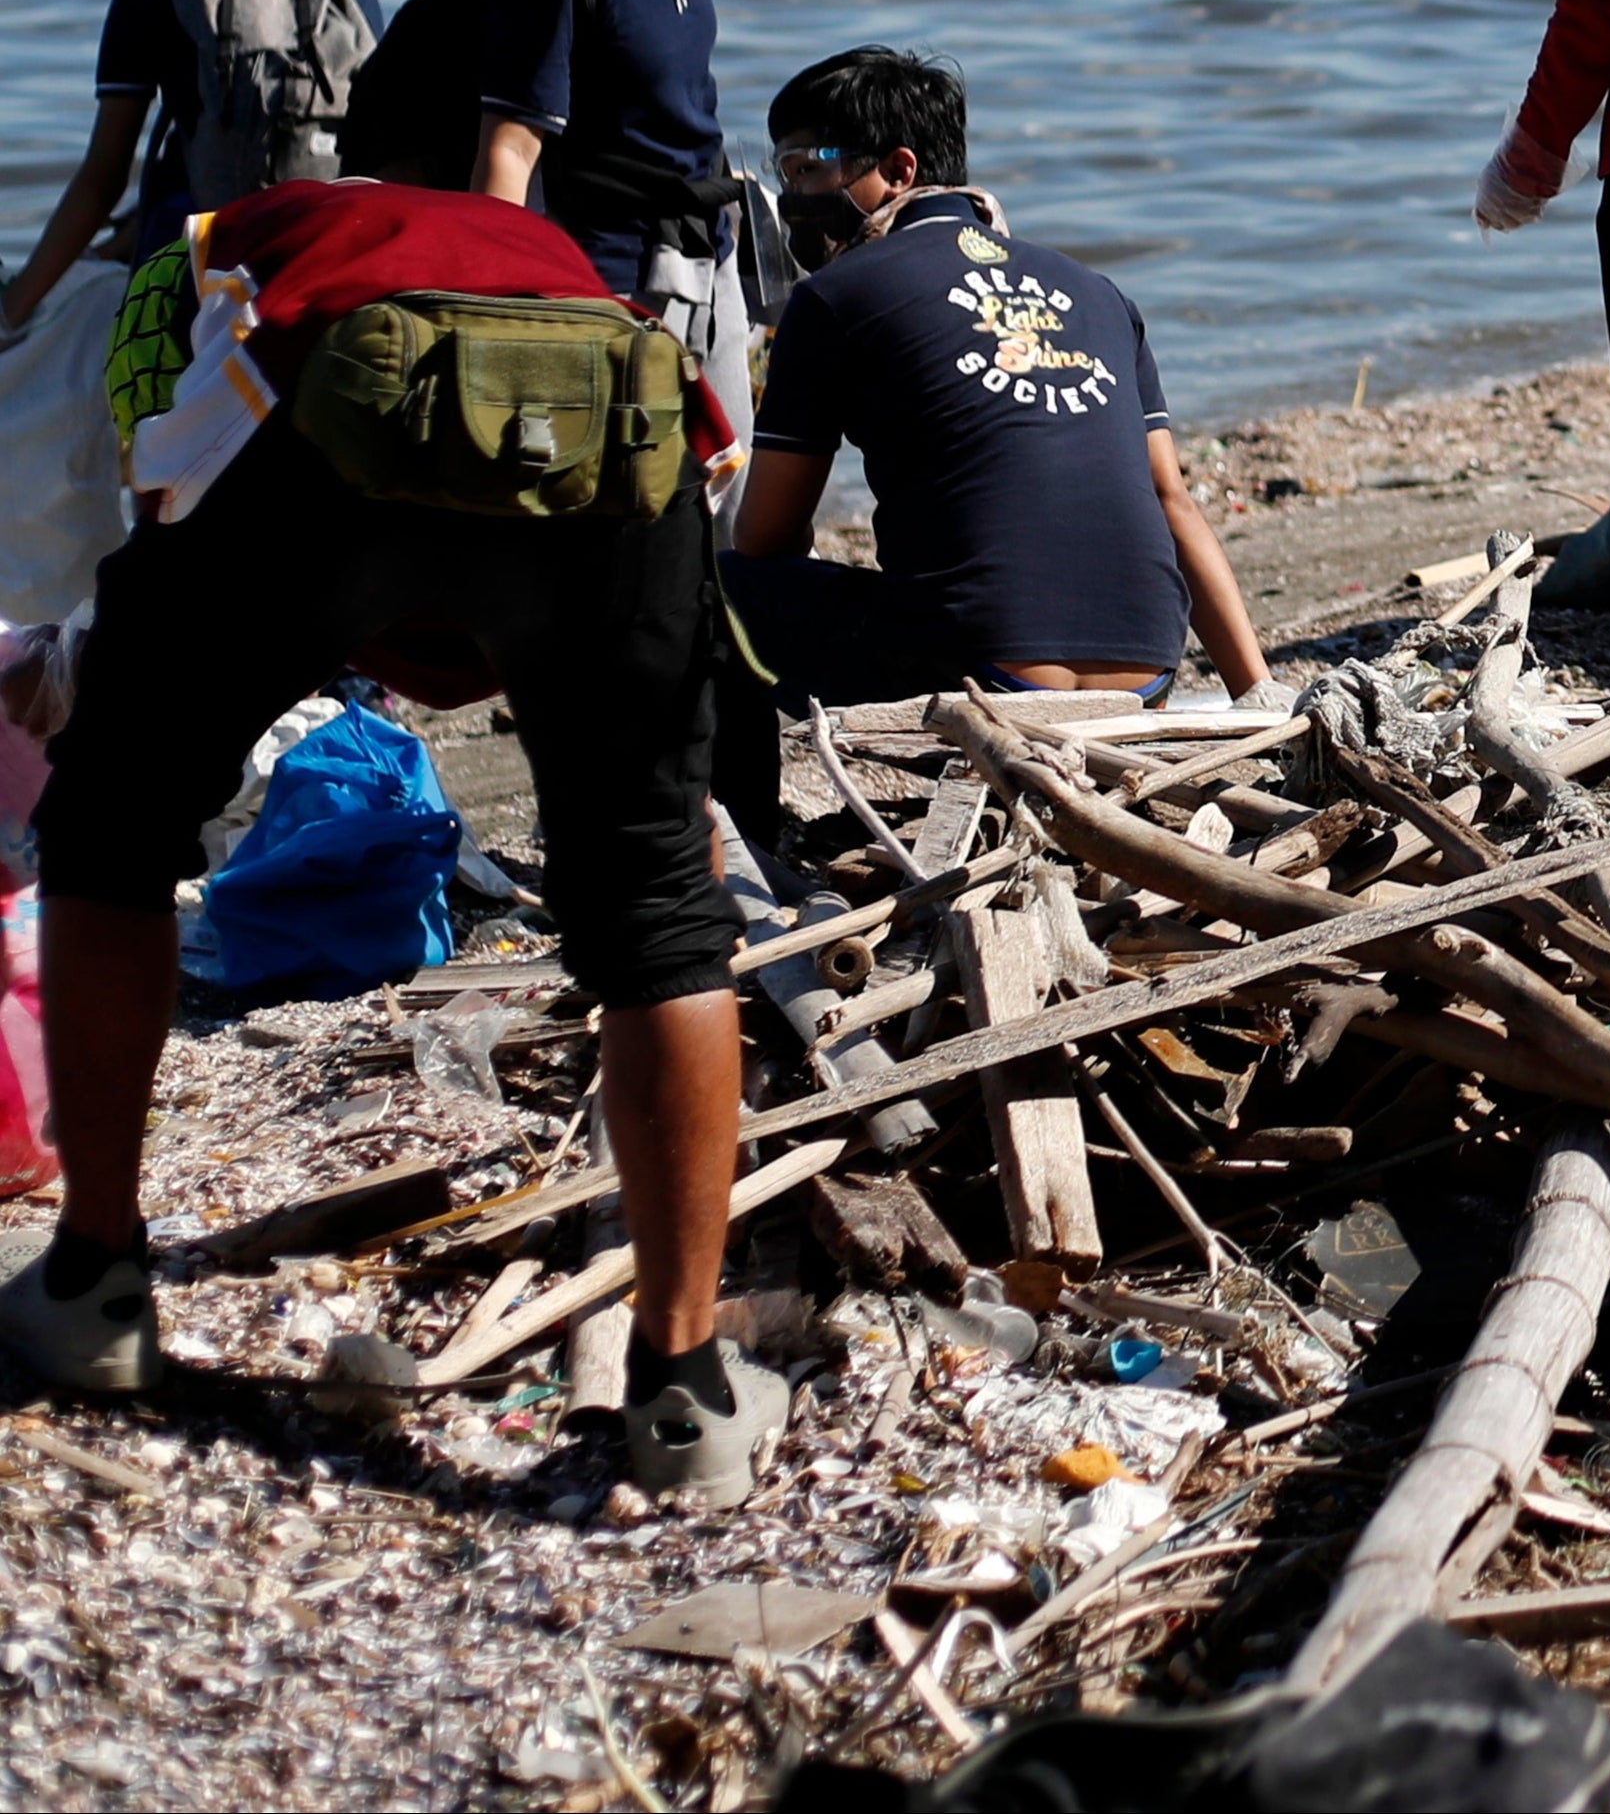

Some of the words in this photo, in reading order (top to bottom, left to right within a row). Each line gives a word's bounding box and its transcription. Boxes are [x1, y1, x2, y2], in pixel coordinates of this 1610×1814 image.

[948, 267, 1073, 312] BREAD
[972, 294, 1064, 336] Light
[994, 332, 1094, 374] Shine
[956, 351, 1117, 414] SOCIETY
